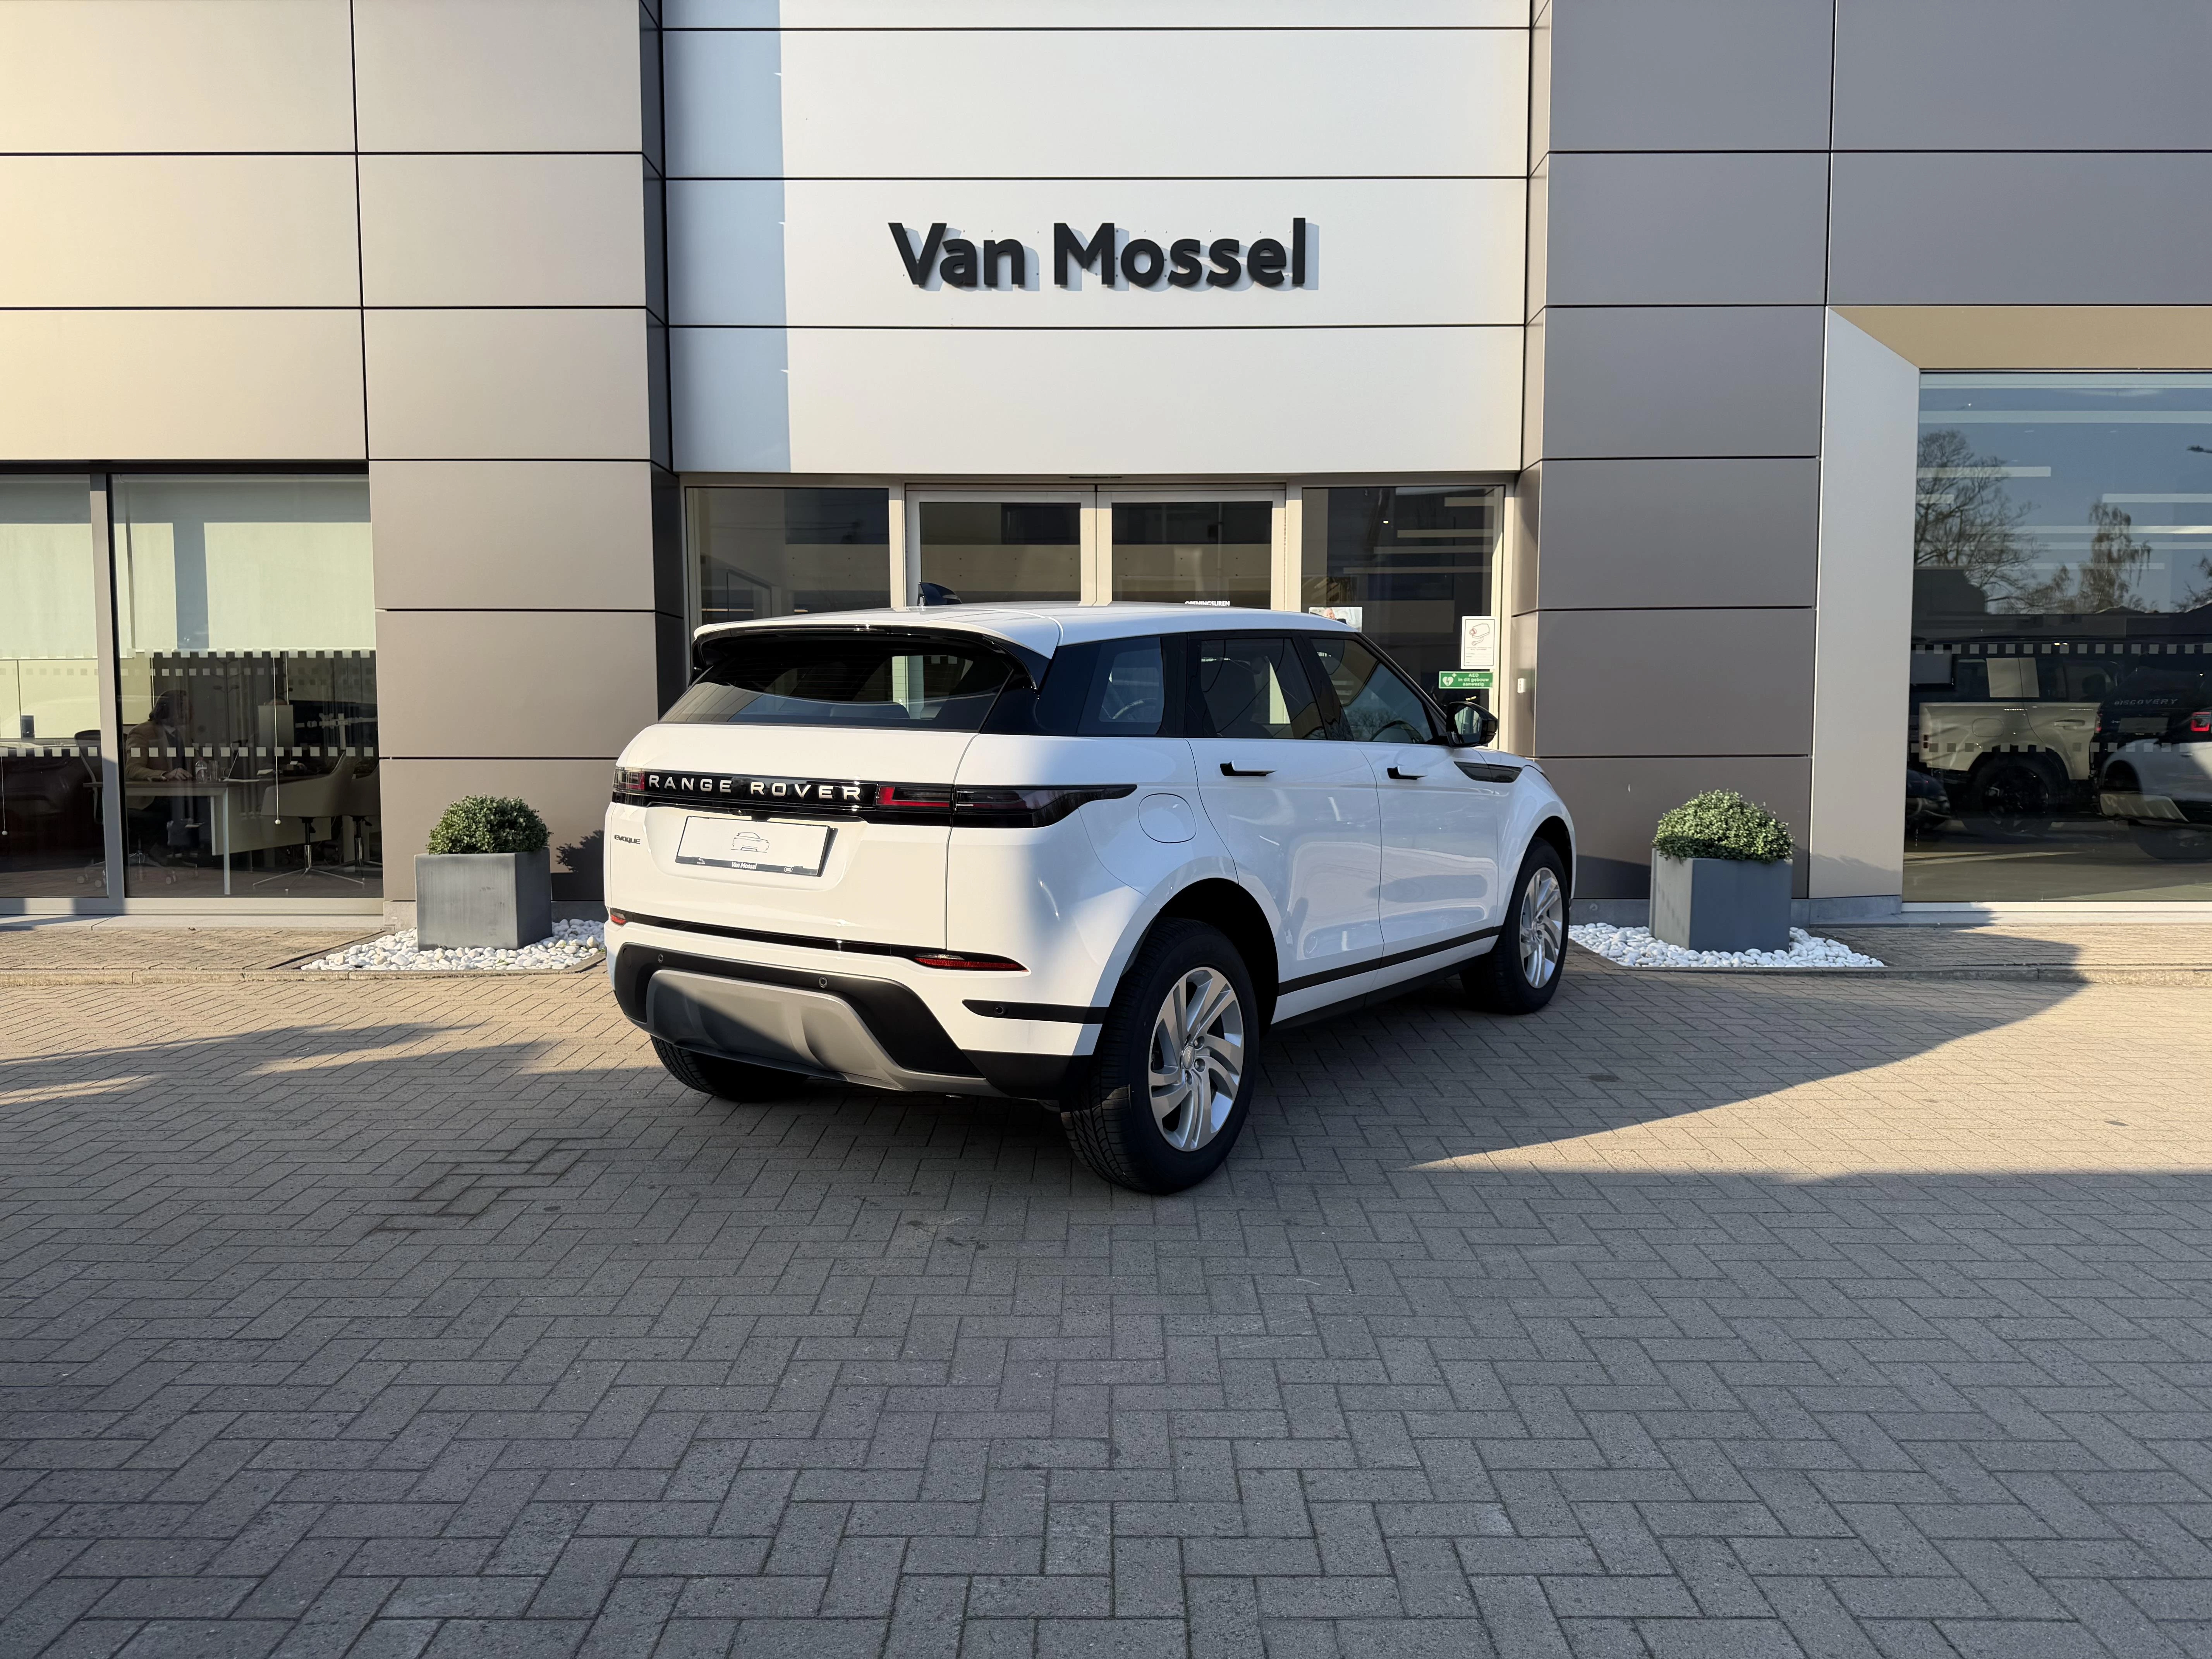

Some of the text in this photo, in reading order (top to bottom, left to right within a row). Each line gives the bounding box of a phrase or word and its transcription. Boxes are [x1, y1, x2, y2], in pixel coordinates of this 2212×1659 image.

[888, 218, 1305, 286] Van Mossel
[649, 775, 860, 800] RANGE ROVER
